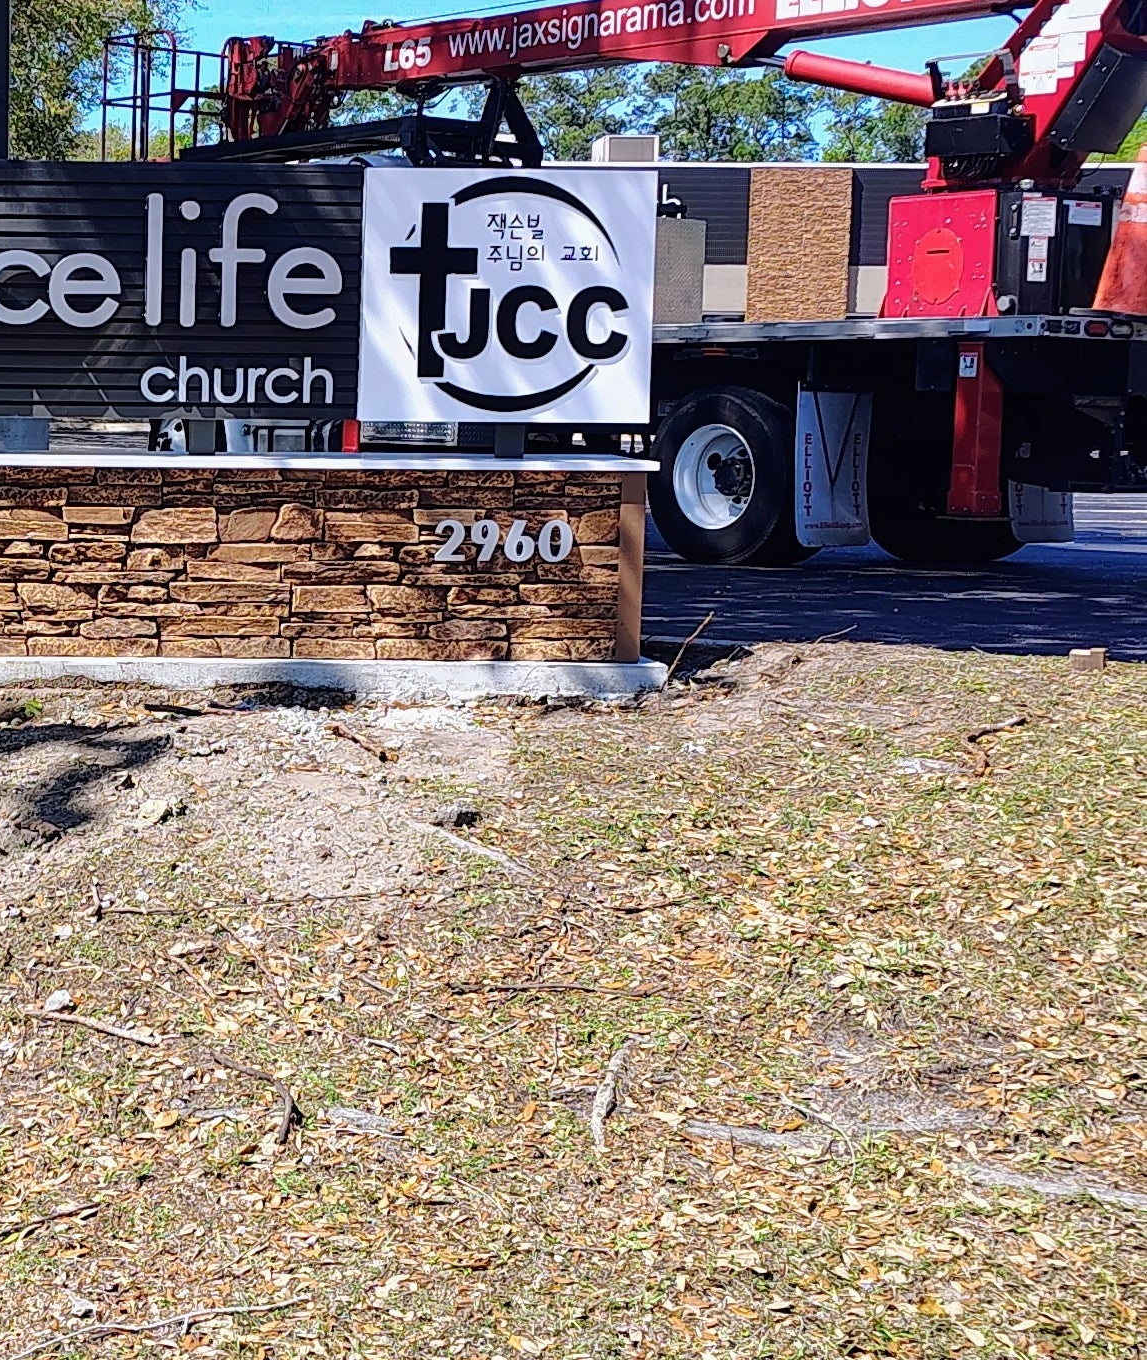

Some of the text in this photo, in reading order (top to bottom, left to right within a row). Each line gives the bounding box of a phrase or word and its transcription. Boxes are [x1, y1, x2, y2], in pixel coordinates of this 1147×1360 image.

[384, 37, 431, 72] L65
[146, 192, 343, 329] life
[486, 245, 599, 271] 주님의 교회
[140, 356, 334, 404] church
[803, 432, 813, 517] ELLIOTT
[434, 519, 574, 564] 2960
